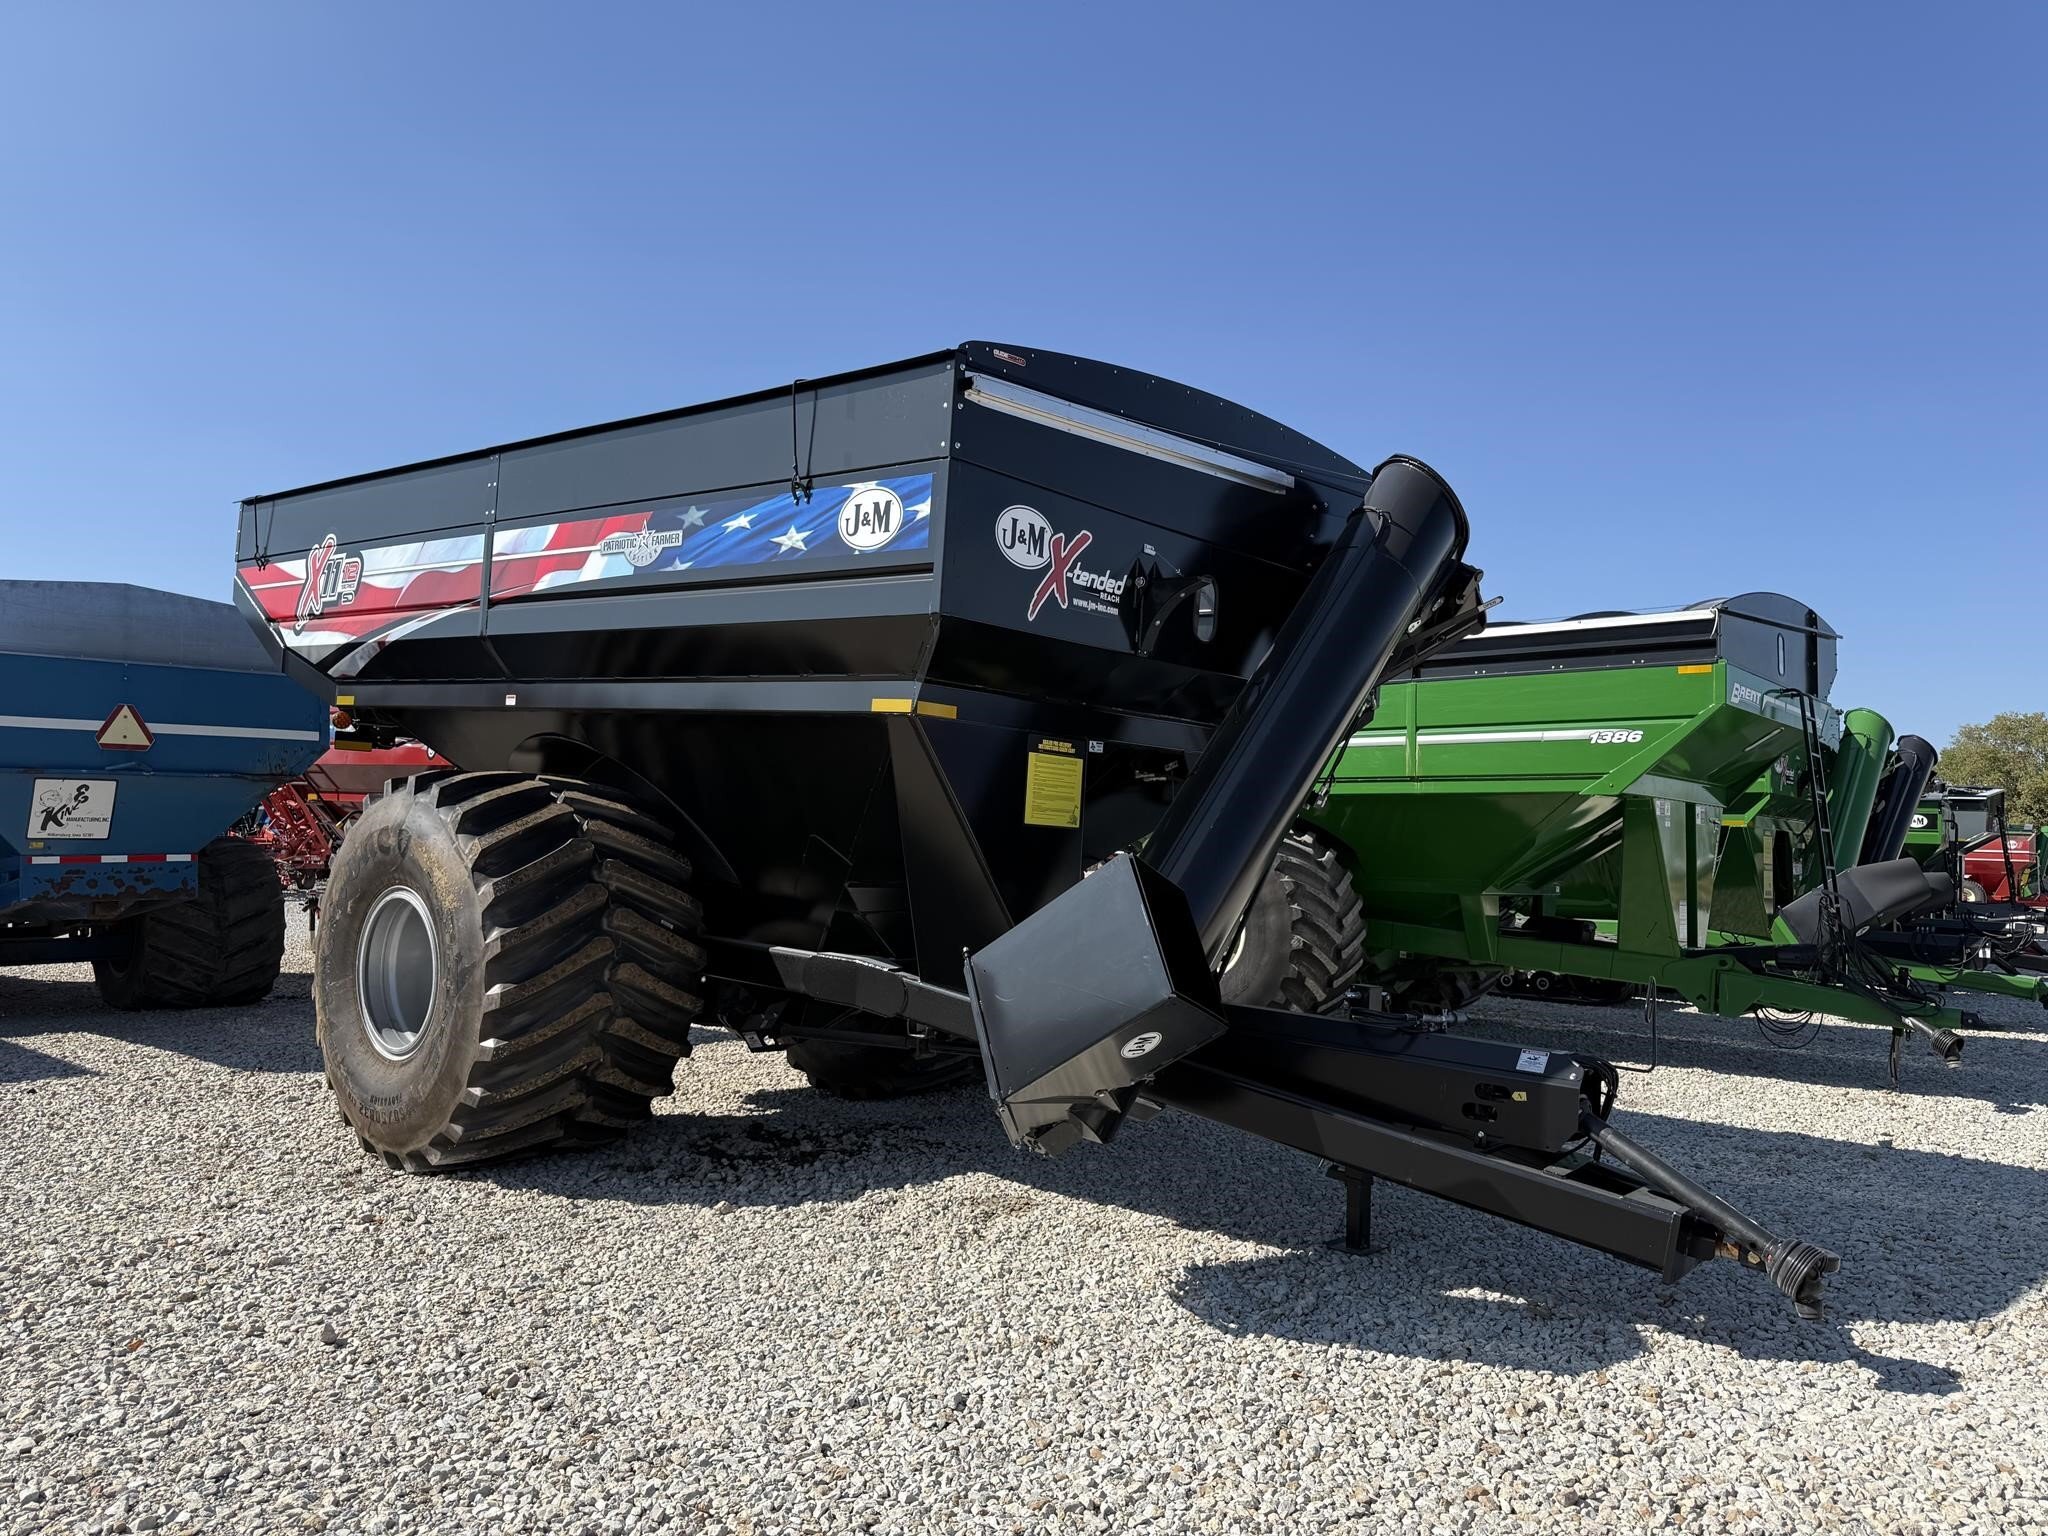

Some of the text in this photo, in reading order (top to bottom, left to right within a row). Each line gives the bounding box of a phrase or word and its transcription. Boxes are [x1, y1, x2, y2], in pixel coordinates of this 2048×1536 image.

[844, 500, 893, 537] J&M
[603, 532, 680, 552] PATRIOTIC FARMER
[1001, 516, 1047, 559] J&M
[1073, 597, 1119, 616] www.jm-inc.com
[1100, 592, 1120, 604] REACH
[1731, 682, 1762, 704] BRENT
[1589, 730, 1644, 744] 1386
